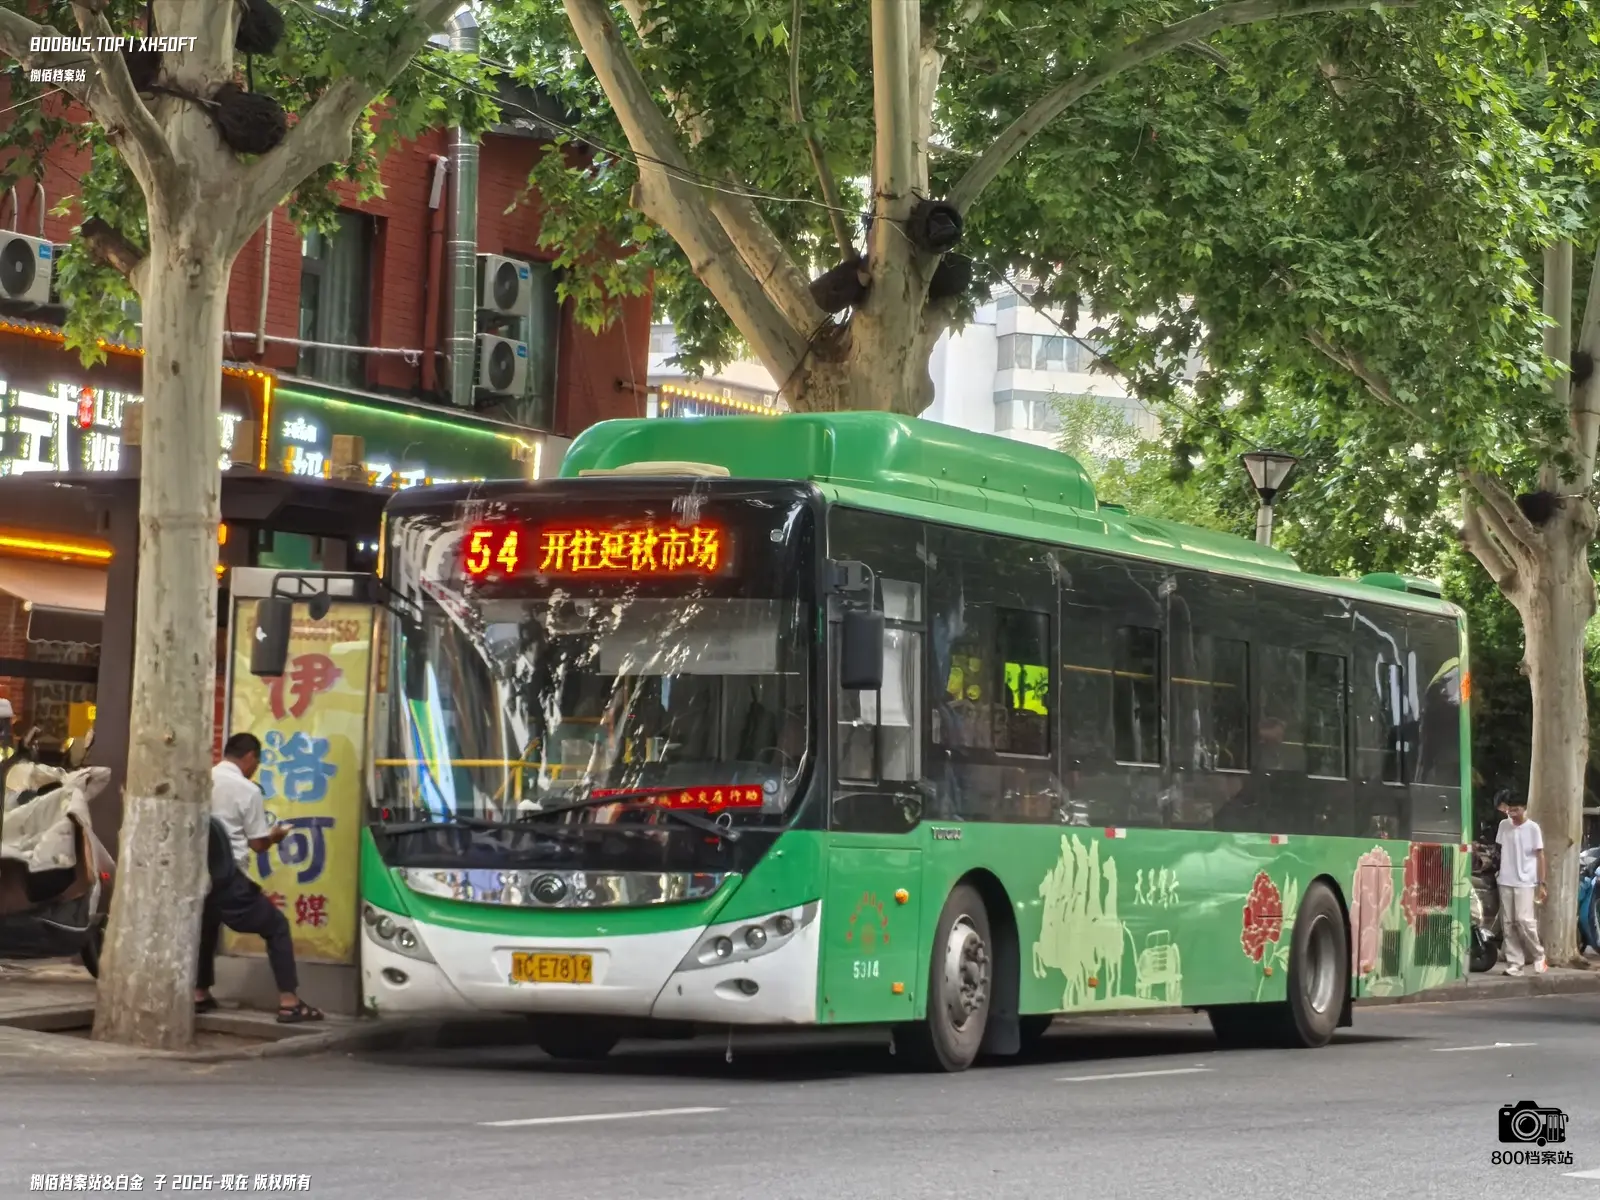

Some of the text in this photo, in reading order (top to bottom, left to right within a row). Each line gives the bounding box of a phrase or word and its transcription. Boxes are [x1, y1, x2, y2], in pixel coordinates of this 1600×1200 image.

[0, 381, 78, 475] 式
[466, 526, 719, 574] 54 开往延秋市场
